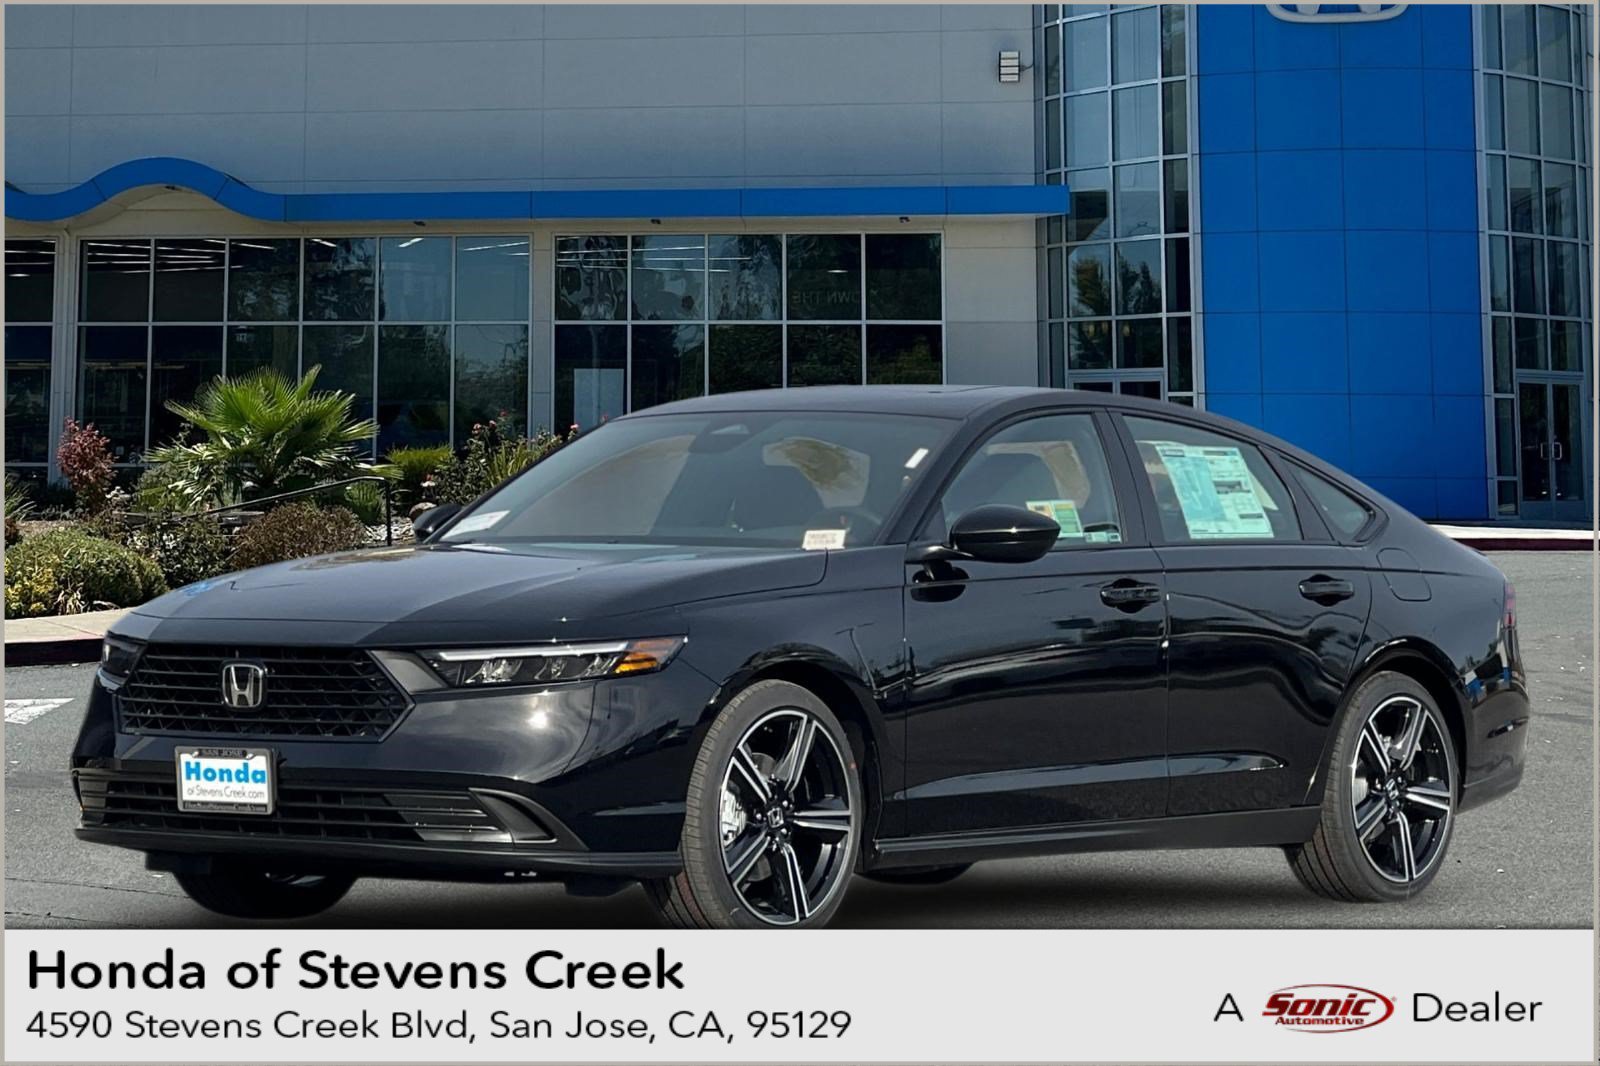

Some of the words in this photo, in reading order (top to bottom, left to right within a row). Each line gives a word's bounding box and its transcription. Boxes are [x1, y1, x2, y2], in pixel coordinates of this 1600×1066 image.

[185, 761, 266, 784] Honda
[196, 785, 223, 798] Stevens
[223, 786, 265, 799] Creek.com
